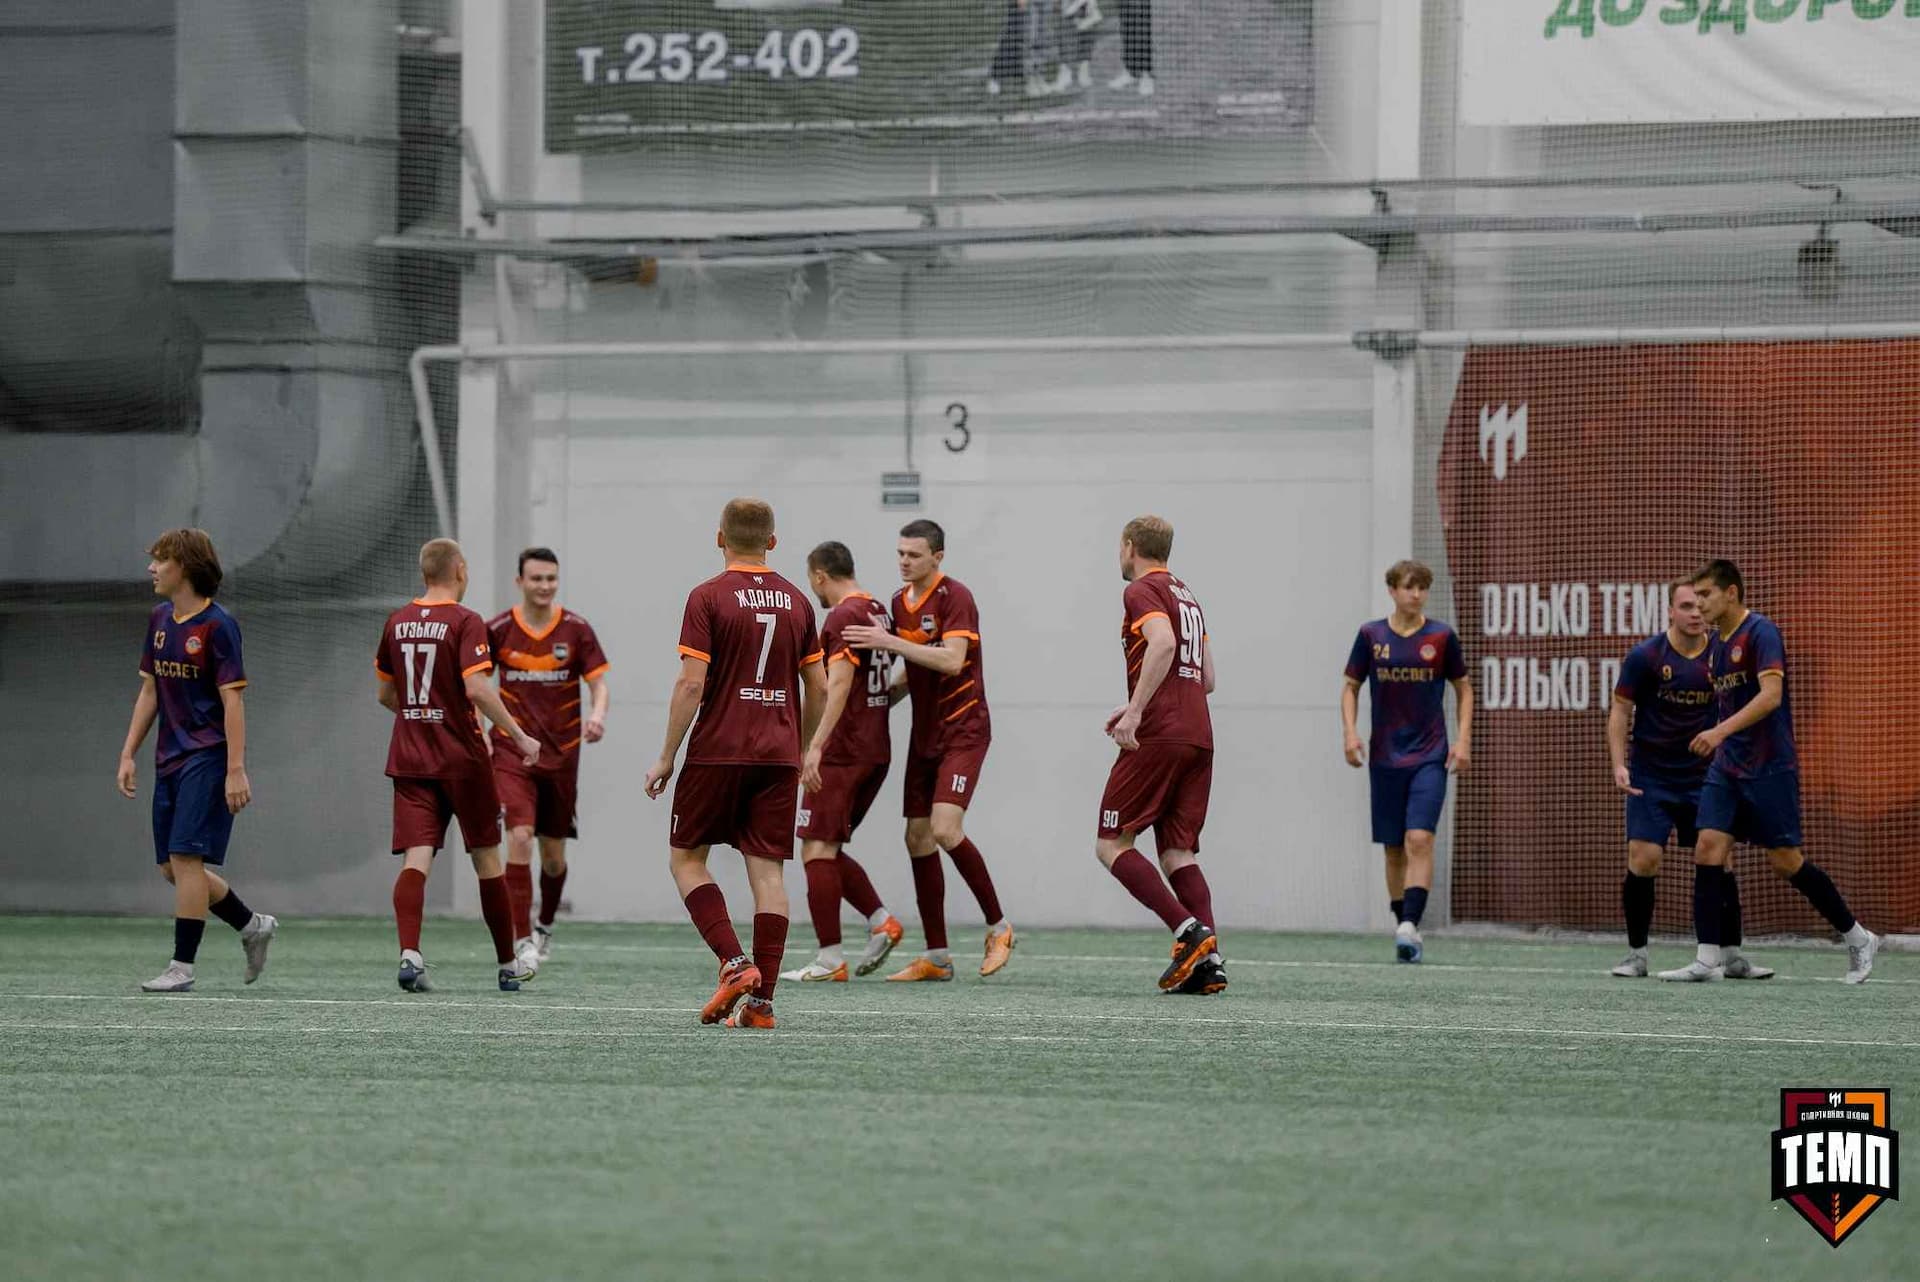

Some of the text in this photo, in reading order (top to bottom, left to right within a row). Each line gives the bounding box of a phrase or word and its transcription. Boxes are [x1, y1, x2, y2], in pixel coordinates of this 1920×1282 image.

[575, 27, 859, 83] т.252-402
[945, 403, 970, 452] 3
[734, 589, 792, 611] ЖДАНОВ
[395, 621, 449, 641] КУЗЬКИН
[1179, 602, 1204, 668] 90
[755, 613, 777, 684] 7
[1373, 644, 1390, 660] 24
[401, 643, 437, 705] 17
[1662, 664, 1673, 681] 9
[740, 687, 787, 702] SEUS
[952, 774, 967, 793] 15
[673, 814, 679, 834] 7
[1103, 810, 1119, 828] 90
